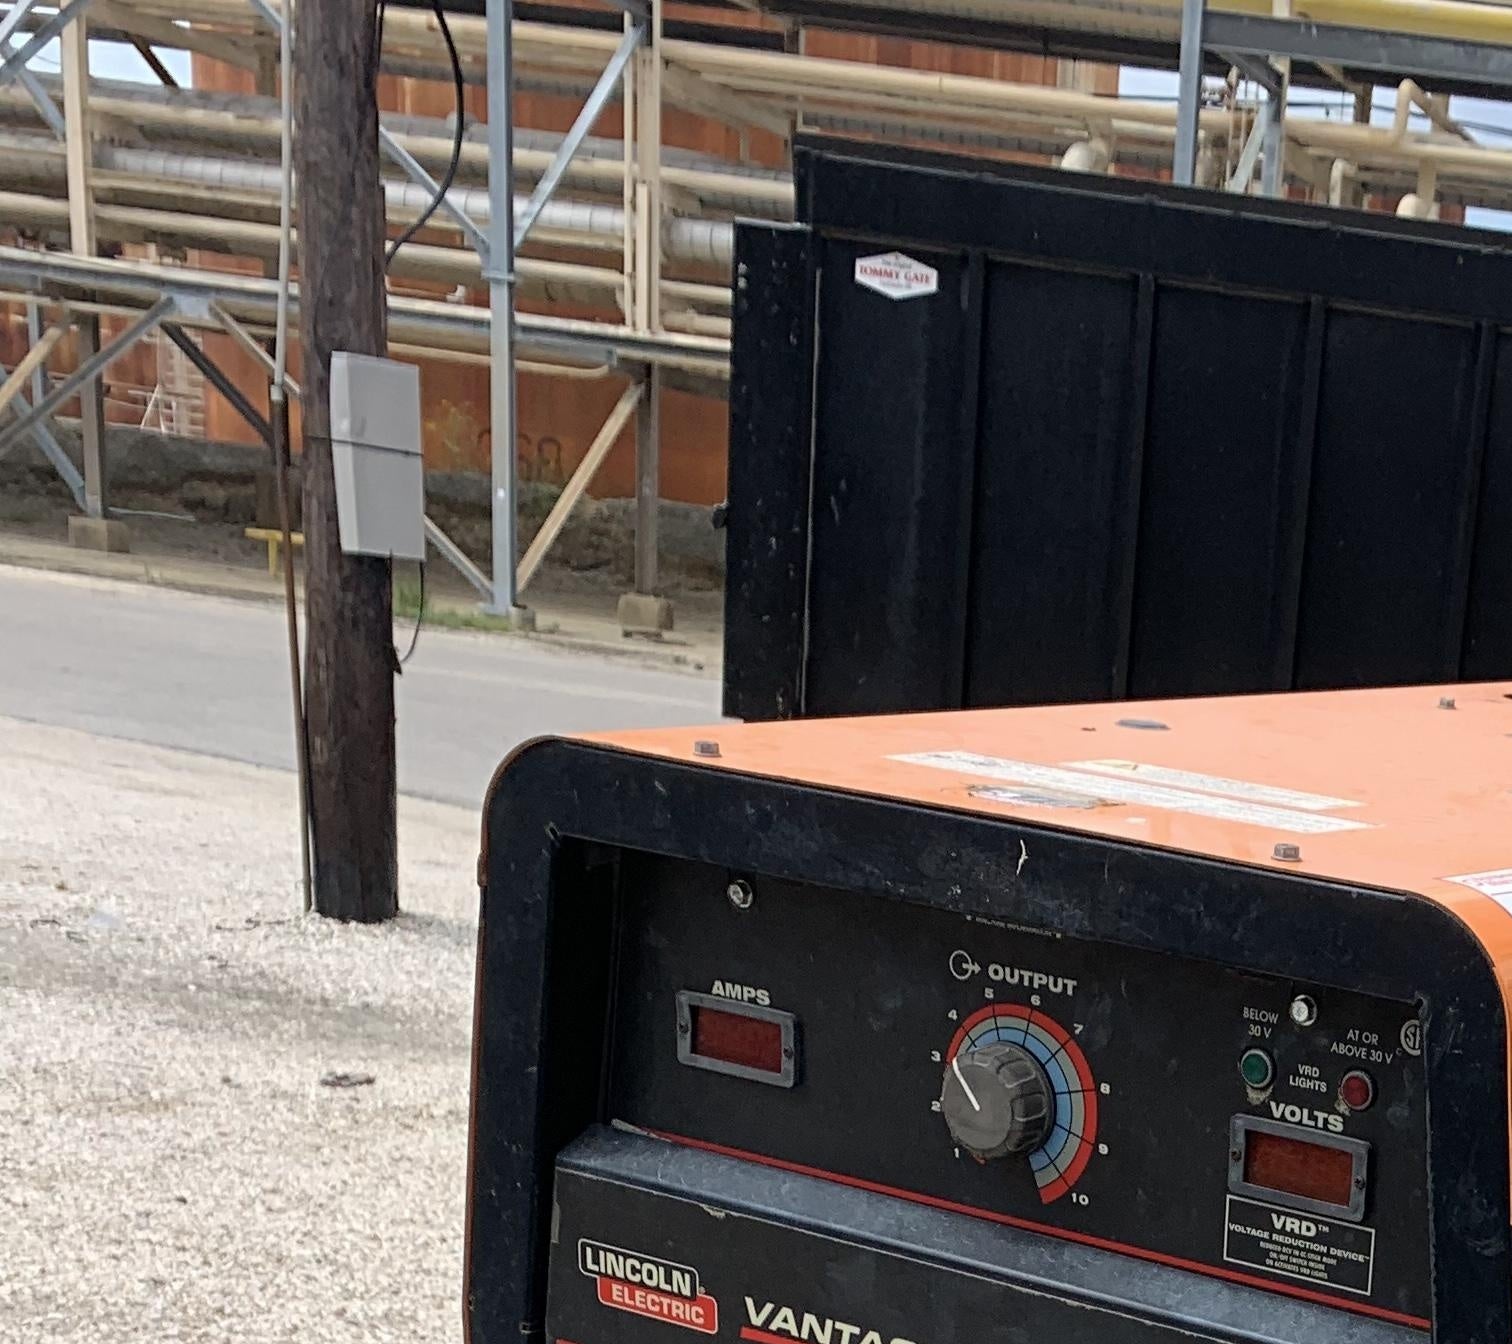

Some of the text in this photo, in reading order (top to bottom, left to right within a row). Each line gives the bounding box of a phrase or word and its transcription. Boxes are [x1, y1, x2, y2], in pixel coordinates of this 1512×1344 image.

[859, 264, 899, 280] TOMMY
[988, 963, 1077, 996] OUTPUT
[711, 979, 771, 1006] AMPS
[984, 987, 994, 999] 5
[1030, 995, 1041, 1006] 6
[948, 1009, 958, 1021] 4
[1243, 1006, 1279, 1024] BELOW
[1073, 1023, 1084, 1035] 7
[1248, 1023, 1272, 1039] 30 V
[1346, 1028, 1379, 1046] AT OR
[931, 1050, 941, 1062] 3
[1330, 1042, 1393, 1065] ABOVE 30 V
[1298, 1063, 1320, 1077] VRD
[1100, 1082, 1111, 1095] 8
[1289, 1075, 1327, 1093] LIGHTS
[931, 1101, 941, 1112] 2
[1269, 1100, 1344, 1133] VOLTS
[954, 1147, 960, 1159] 1
[1098, 1143, 1109, 1156] 9
[1071, 1192, 1089, 1206] 10
[1228, 1222, 1327, 1255] VOLTAGE REDUCTION
[585, 1246, 691, 1297] LINCOLN
[611, 1283, 705, 1325] ELECTRIC
